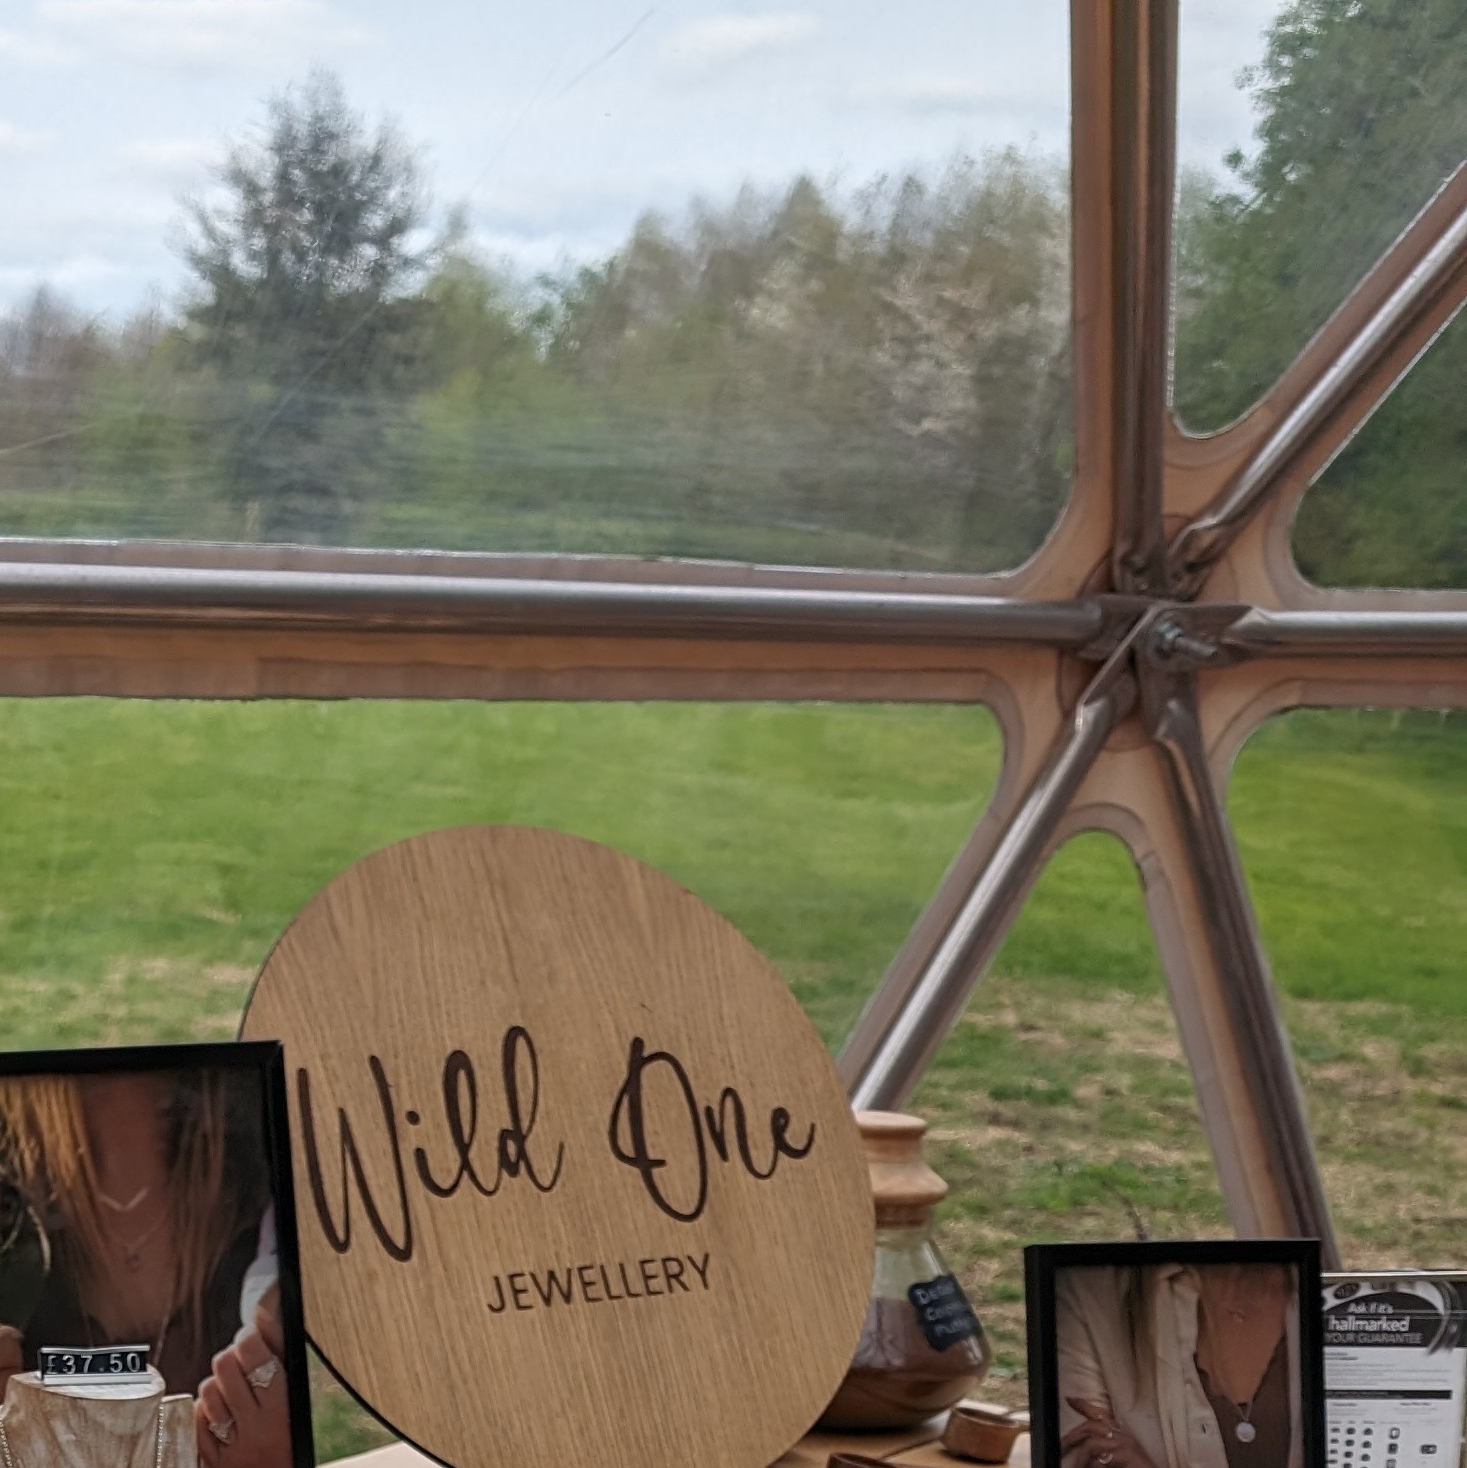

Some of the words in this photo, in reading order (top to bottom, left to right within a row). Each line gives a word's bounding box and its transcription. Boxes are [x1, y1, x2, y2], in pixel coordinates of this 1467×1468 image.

[297, 1025, 564, 1262] Wild
[608, 1036, 817, 1222] One
[486, 1252, 711, 1315] JEWELLERY
[1327, 1314, 1411, 1332] hallmarked
[46, 1352, 141, 1375] £37.50
